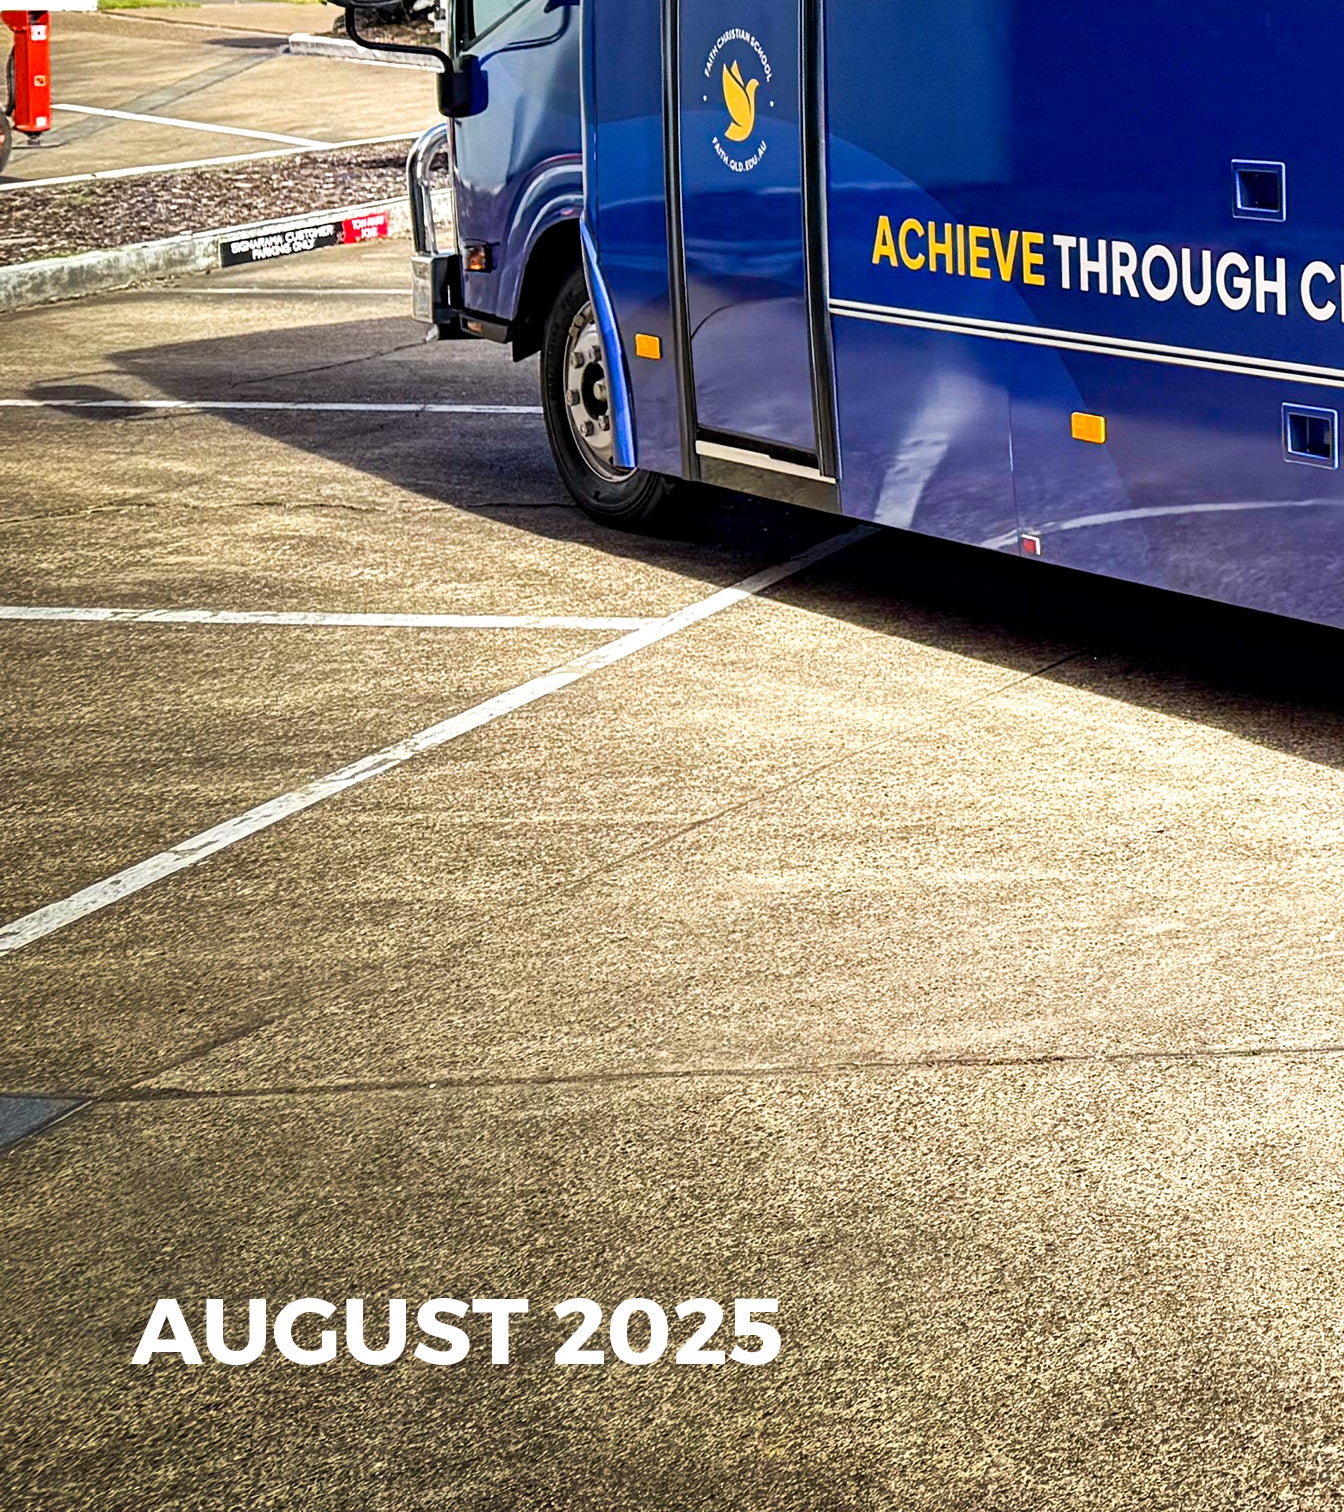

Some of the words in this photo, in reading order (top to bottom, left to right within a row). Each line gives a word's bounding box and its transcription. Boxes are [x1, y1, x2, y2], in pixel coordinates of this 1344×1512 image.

[704, 46, 719, 78] FAITH
[716, 28, 751, 49] CHRISTIAN
[749, 37, 774, 83] SCHOOL
[711, 137, 767, 173] FAITH.QLD.EDU.AU
[871, 215, 1045, 287] ACHIEVE
[1052, 234, 1287, 316] THROUGH
